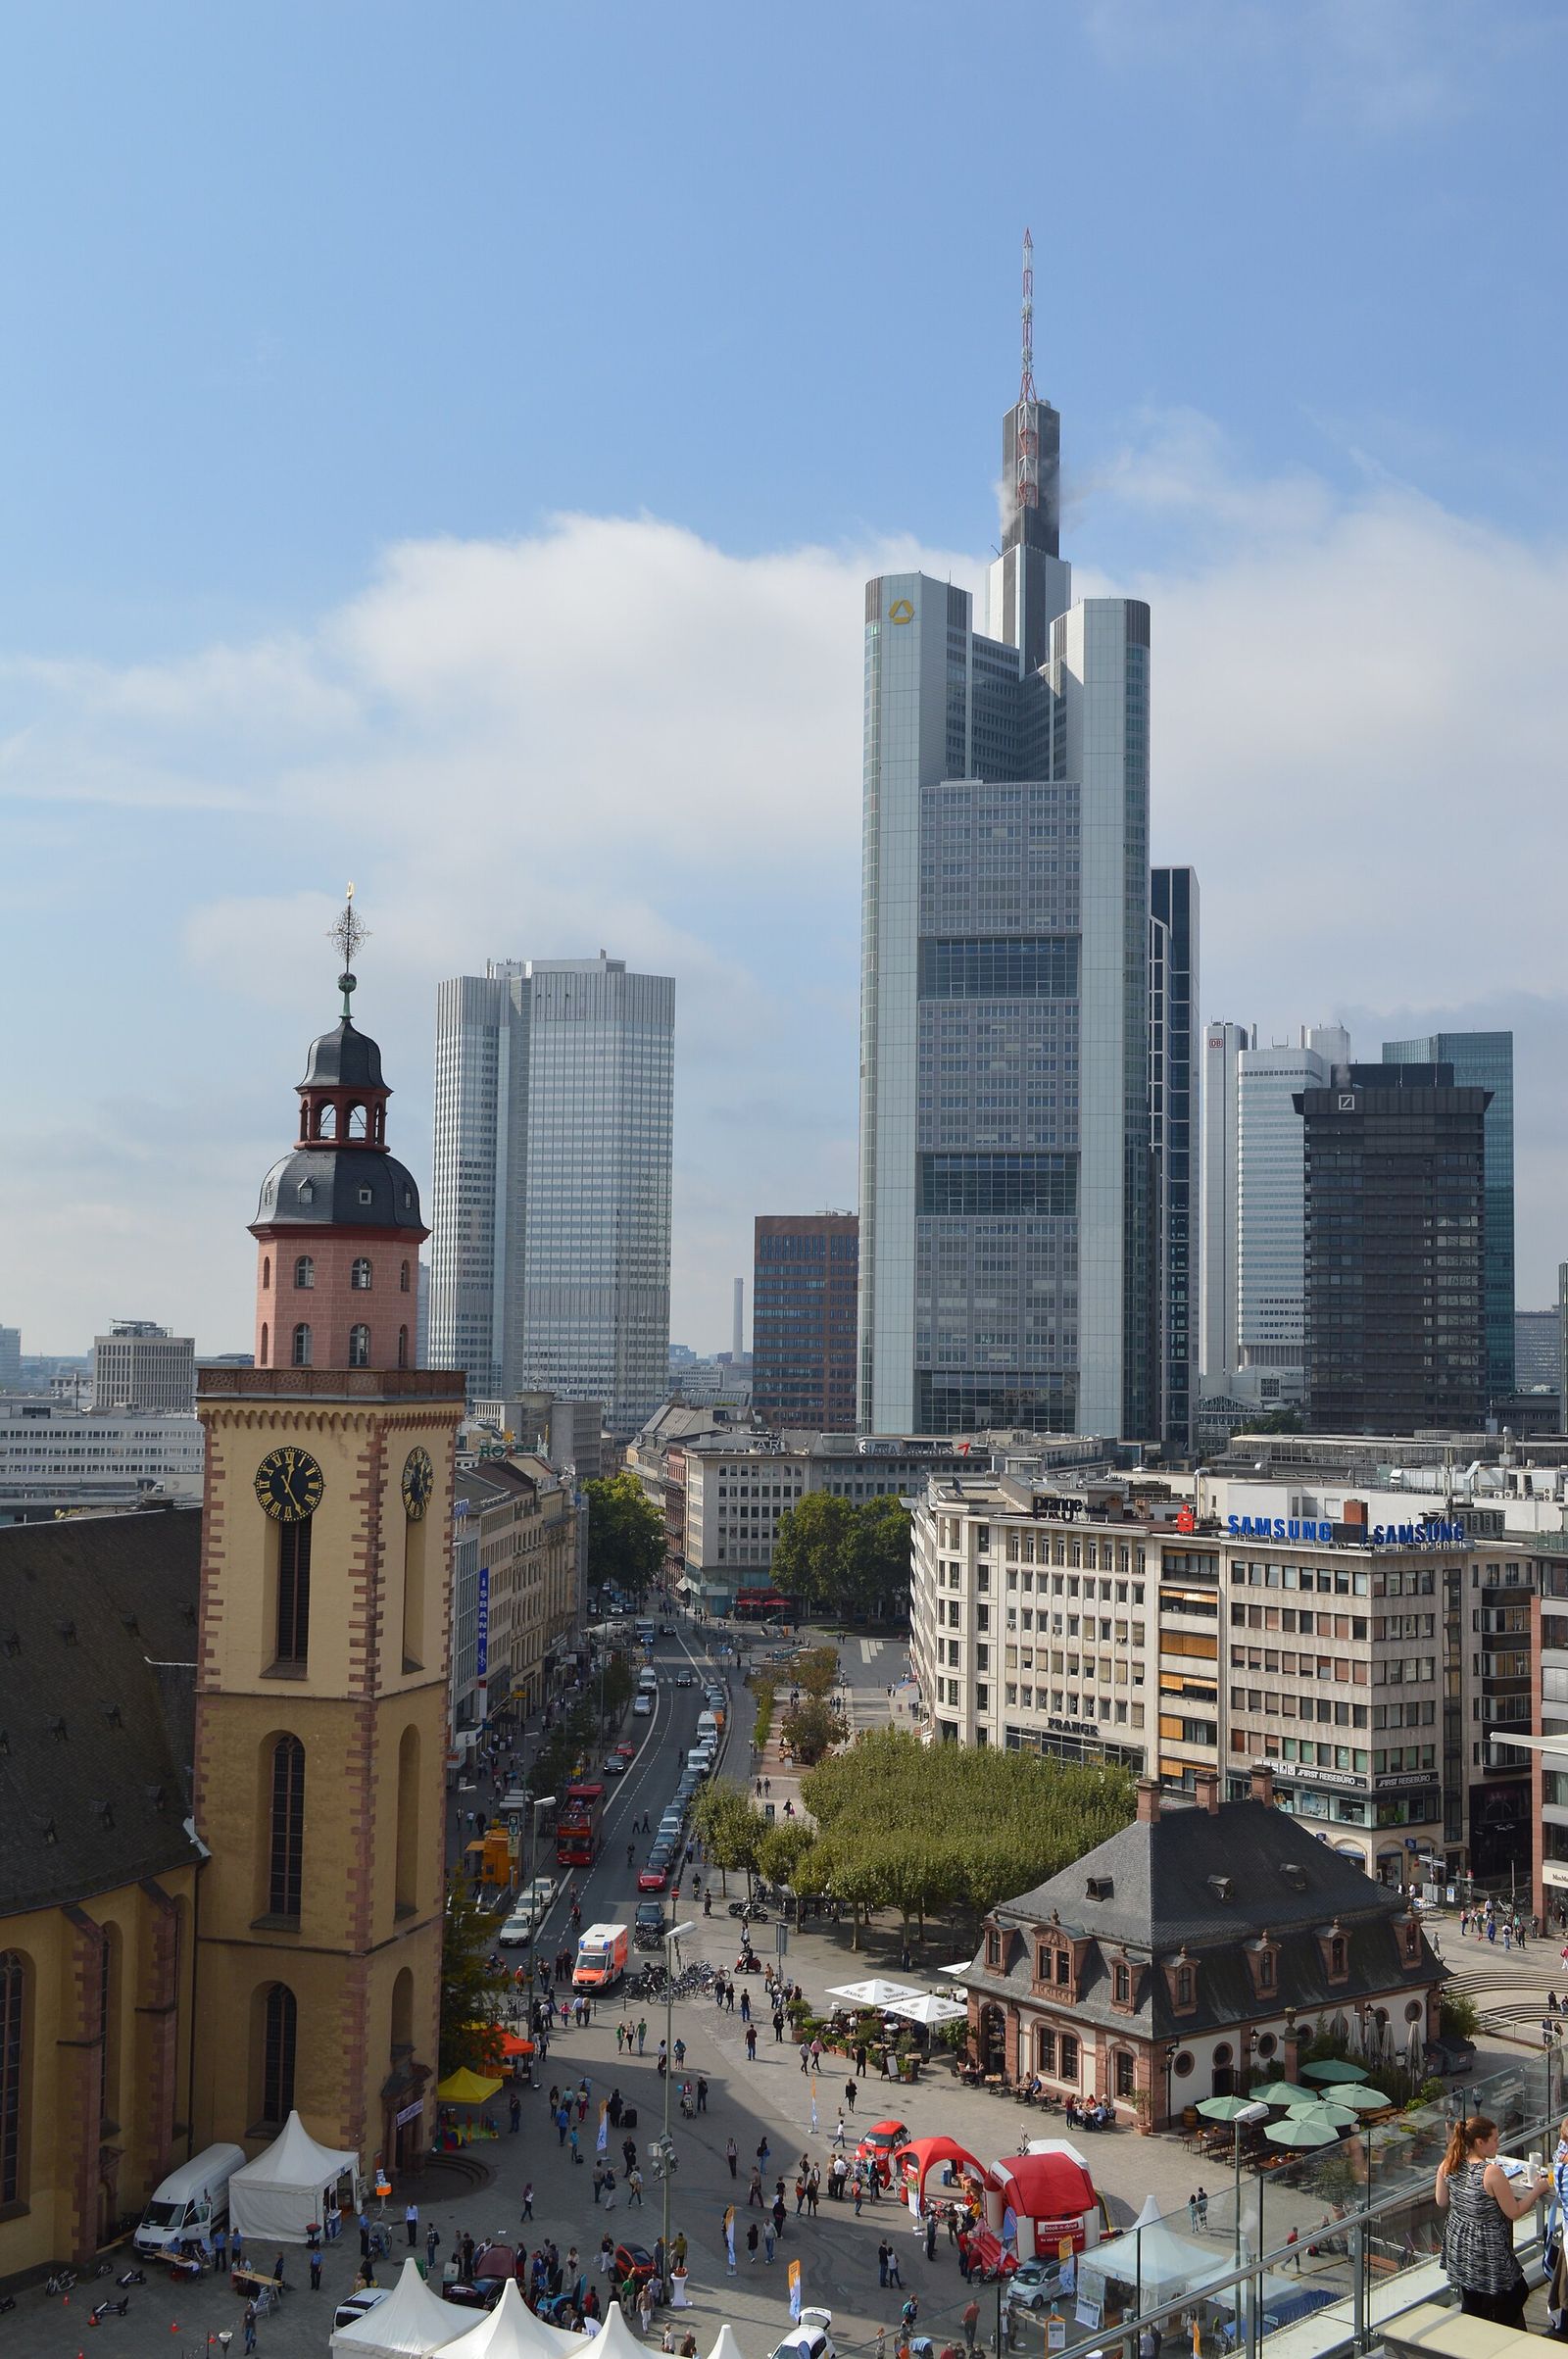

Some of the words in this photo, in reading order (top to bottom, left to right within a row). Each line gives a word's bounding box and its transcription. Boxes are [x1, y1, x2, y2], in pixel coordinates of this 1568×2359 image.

[853, 1445, 897, 1455] ASIANA
[1032, 1494, 1082, 1522] prange
[1228, 1515, 1332, 1542] SAMSUNG
[1373, 1522, 1465, 1545] SAMSUNG
[1048, 1717, 1100, 1736] PRANGE
[1319, 1771, 1355, 1785] REISEBÜRO
[1398, 1774, 1430, 1785] REISEBÜRO
[1045, 2223, 1078, 2232] book-n-drive
